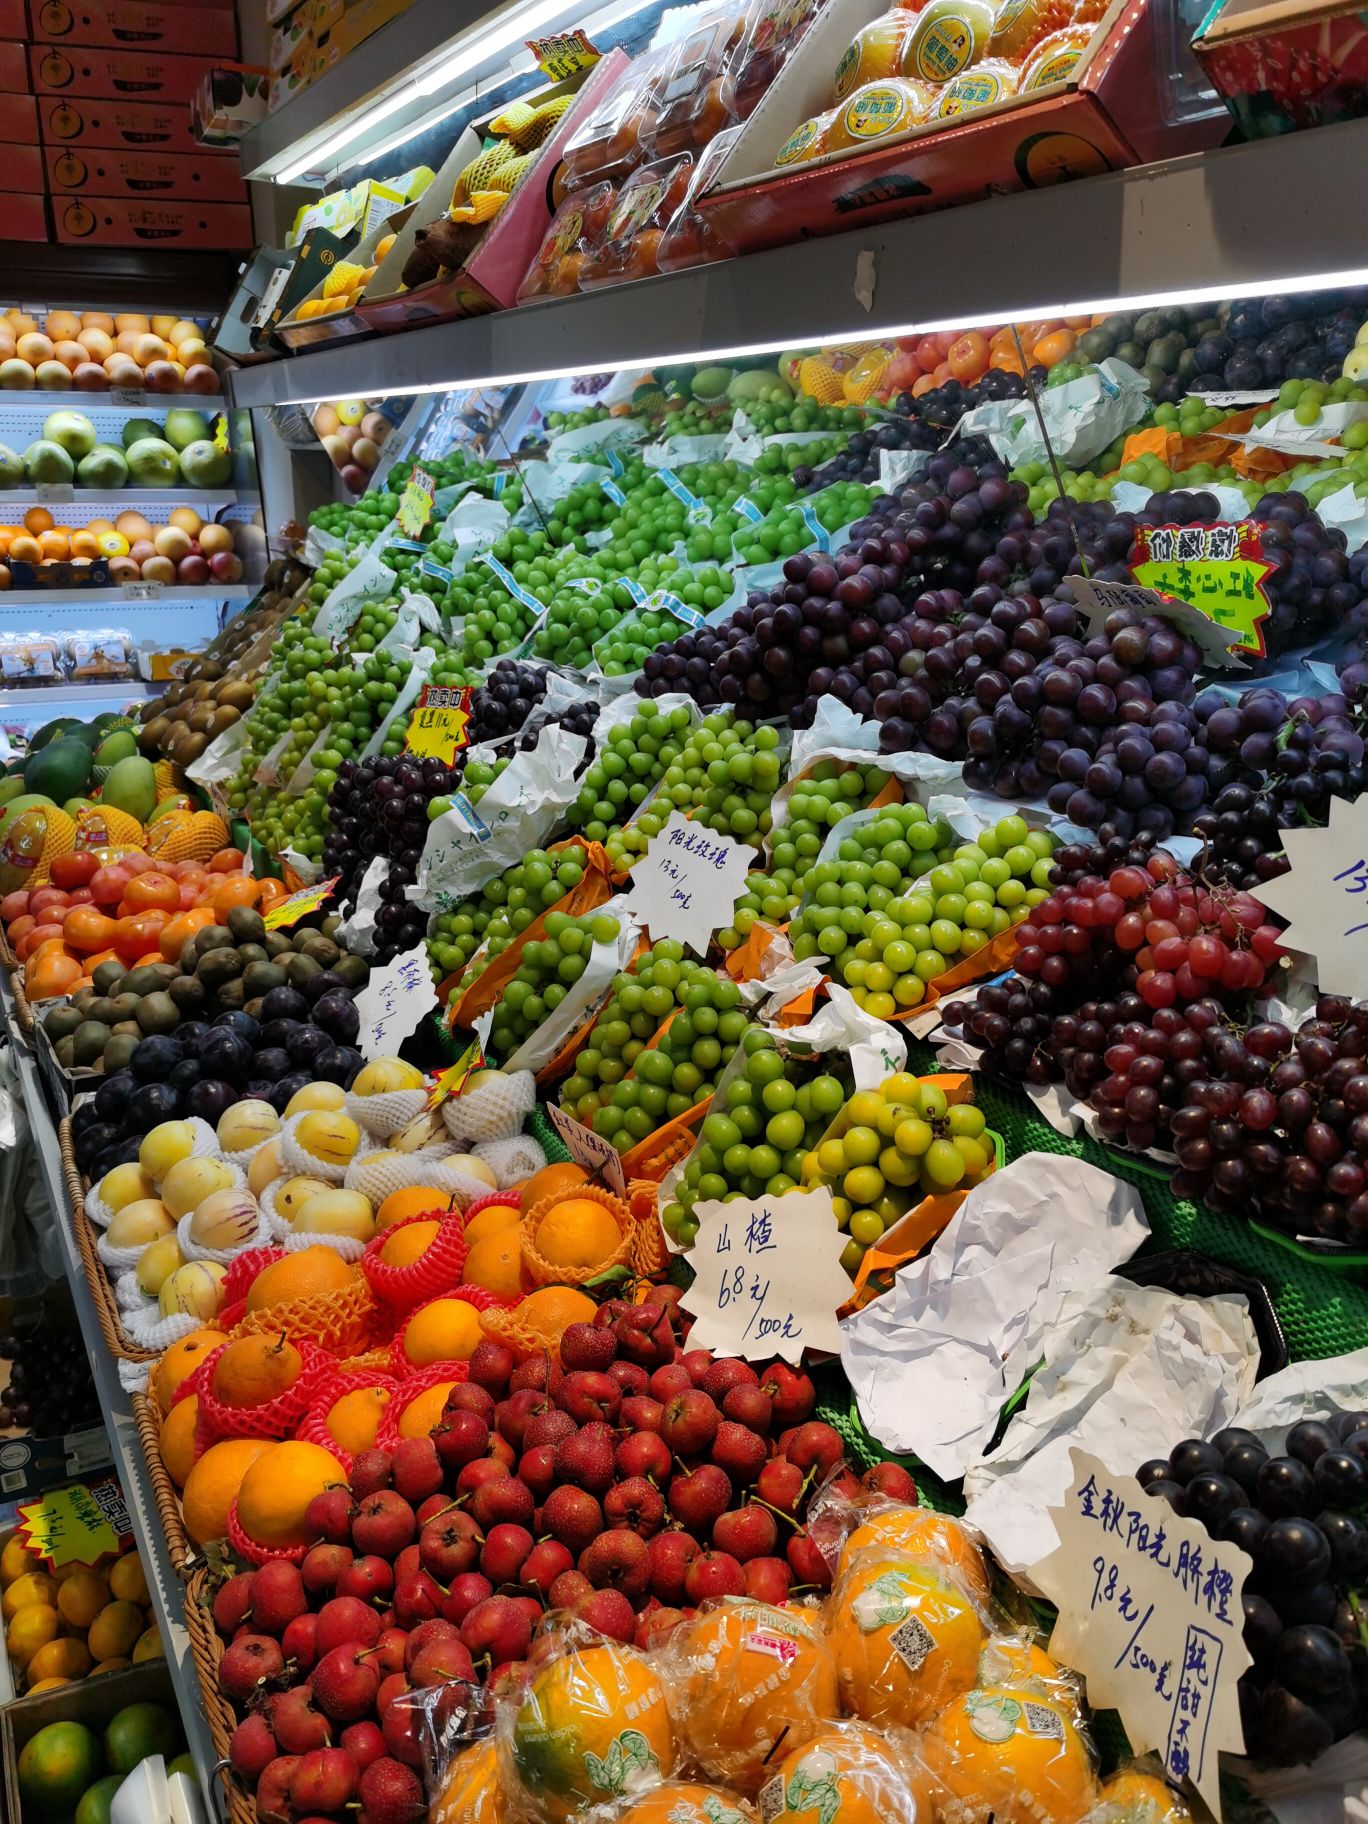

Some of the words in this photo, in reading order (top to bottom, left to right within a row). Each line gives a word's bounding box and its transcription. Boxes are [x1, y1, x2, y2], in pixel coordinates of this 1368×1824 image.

[538, 36, 587, 60] 热卖中
[925, 34, 959, 72] 葡萄柚
[426, 687, 463, 709] 热卖中
[669, 828, 730, 870] 阳光玫瑰
[716, 1208, 778, 1255] 山楂
[1077, 1474, 1236, 1628] 金秋阳光脐橙
